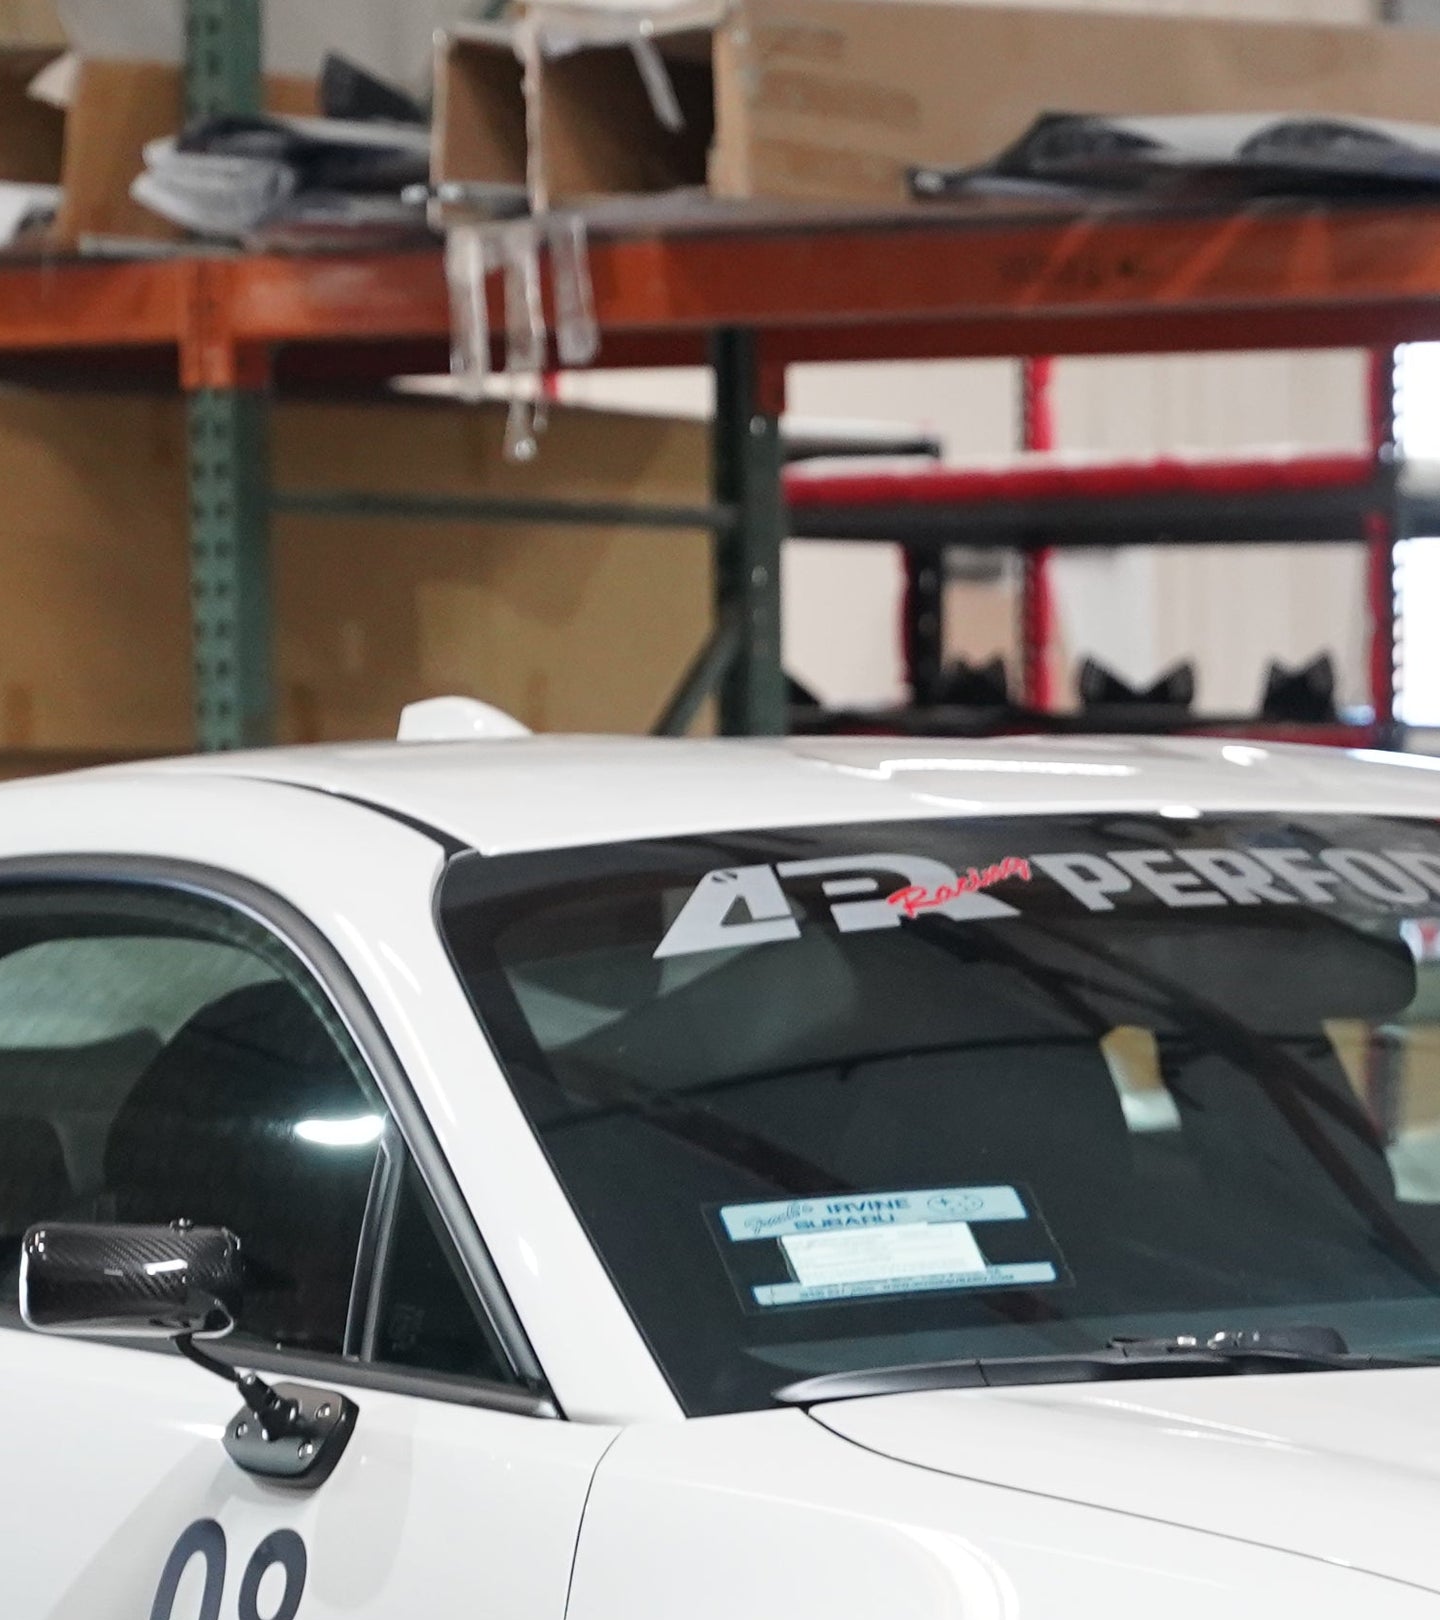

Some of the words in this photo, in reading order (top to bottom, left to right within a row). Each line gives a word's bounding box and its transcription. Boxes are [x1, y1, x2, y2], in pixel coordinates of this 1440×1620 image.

[885, 855, 1032, 918] Racing
[825, 1198, 912, 1214] IRVINE
[793, 1213, 896, 1231] SUBARU
